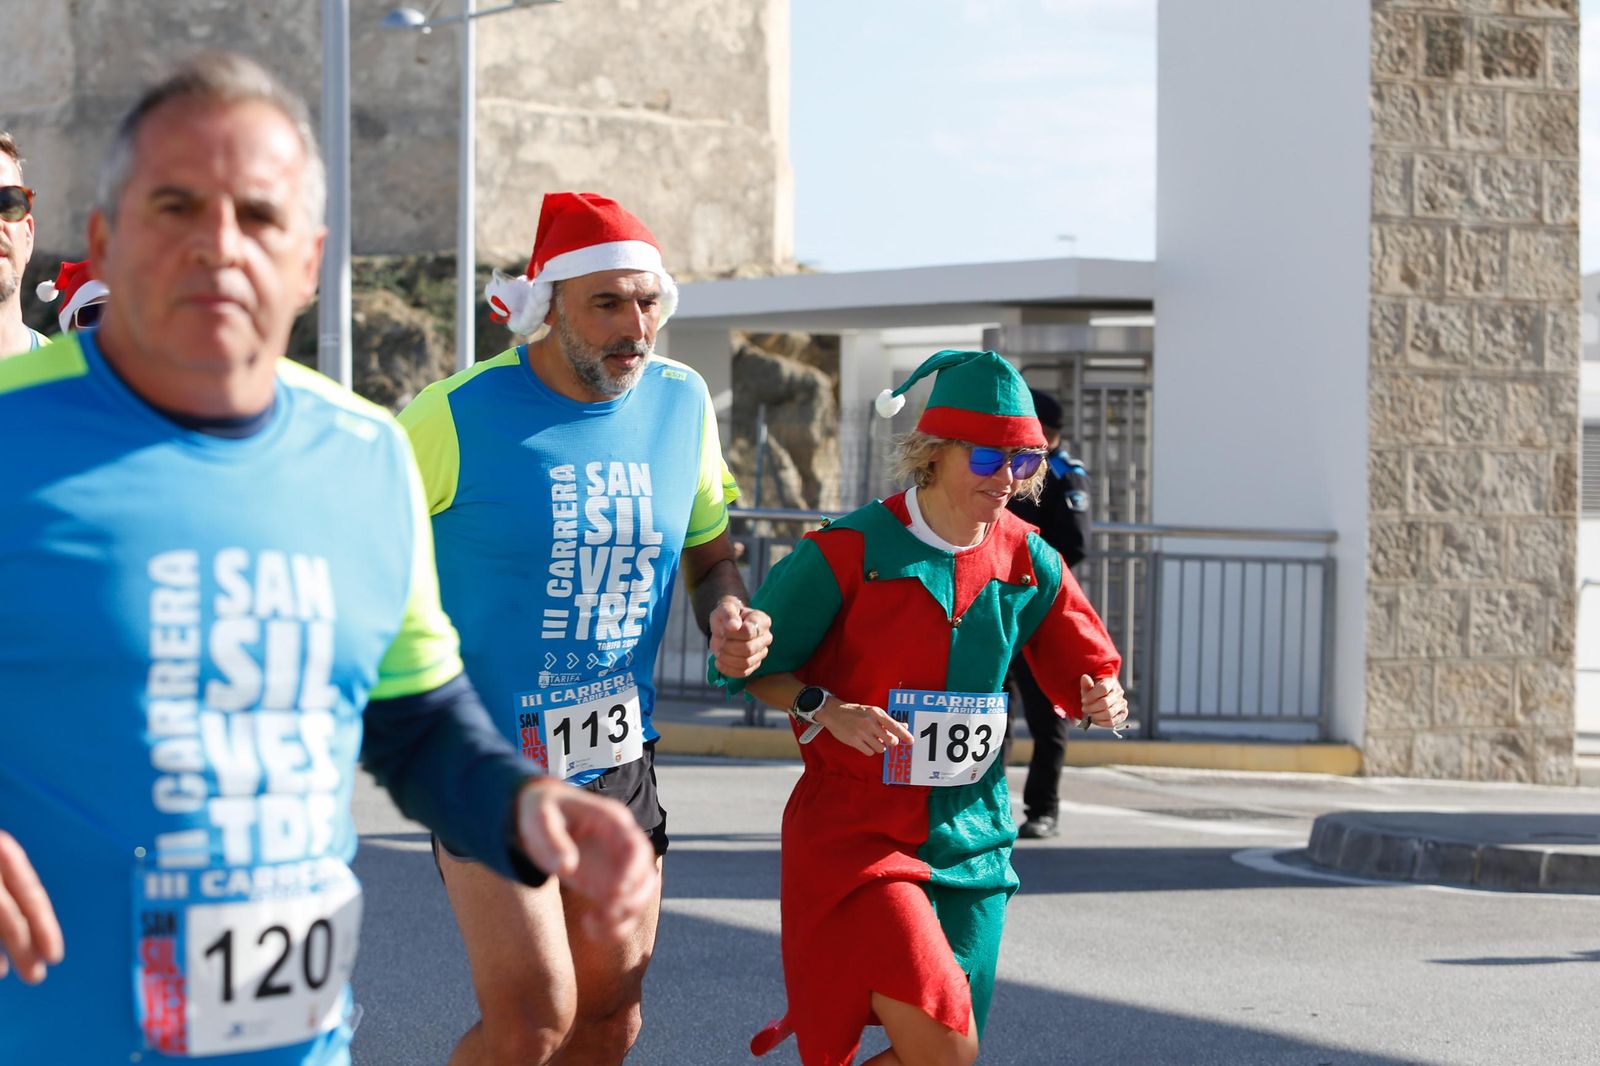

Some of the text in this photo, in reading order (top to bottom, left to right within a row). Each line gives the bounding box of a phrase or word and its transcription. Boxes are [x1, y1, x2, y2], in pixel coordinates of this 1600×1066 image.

[585, 461, 653, 497] SAN
[546, 463, 578, 598] CARRERA
[584, 495, 663, 546] SIL
[211, 546, 336, 622] SAN
[579, 546, 661, 594] VES
[541, 608, 569, 639] III
[574, 590, 651, 641] TRE
[146, 548, 207, 814] CARRERA
[203, 616, 343, 712] SIL
[550, 675, 580, 683] TARIFA
[521, 671, 634, 708] III CARRERA
[576, 691, 610, 704] TARIFA
[895, 693, 1005, 708] III CARRERA
[520, 712, 539, 728] SAN
[521, 727, 541, 749] SIL
[553, 703, 629, 756] 113
[920, 722, 992, 762] 183
[200, 709, 341, 798] VES
[145, 872, 188, 900] III
[204, 918, 334, 1004] 120
